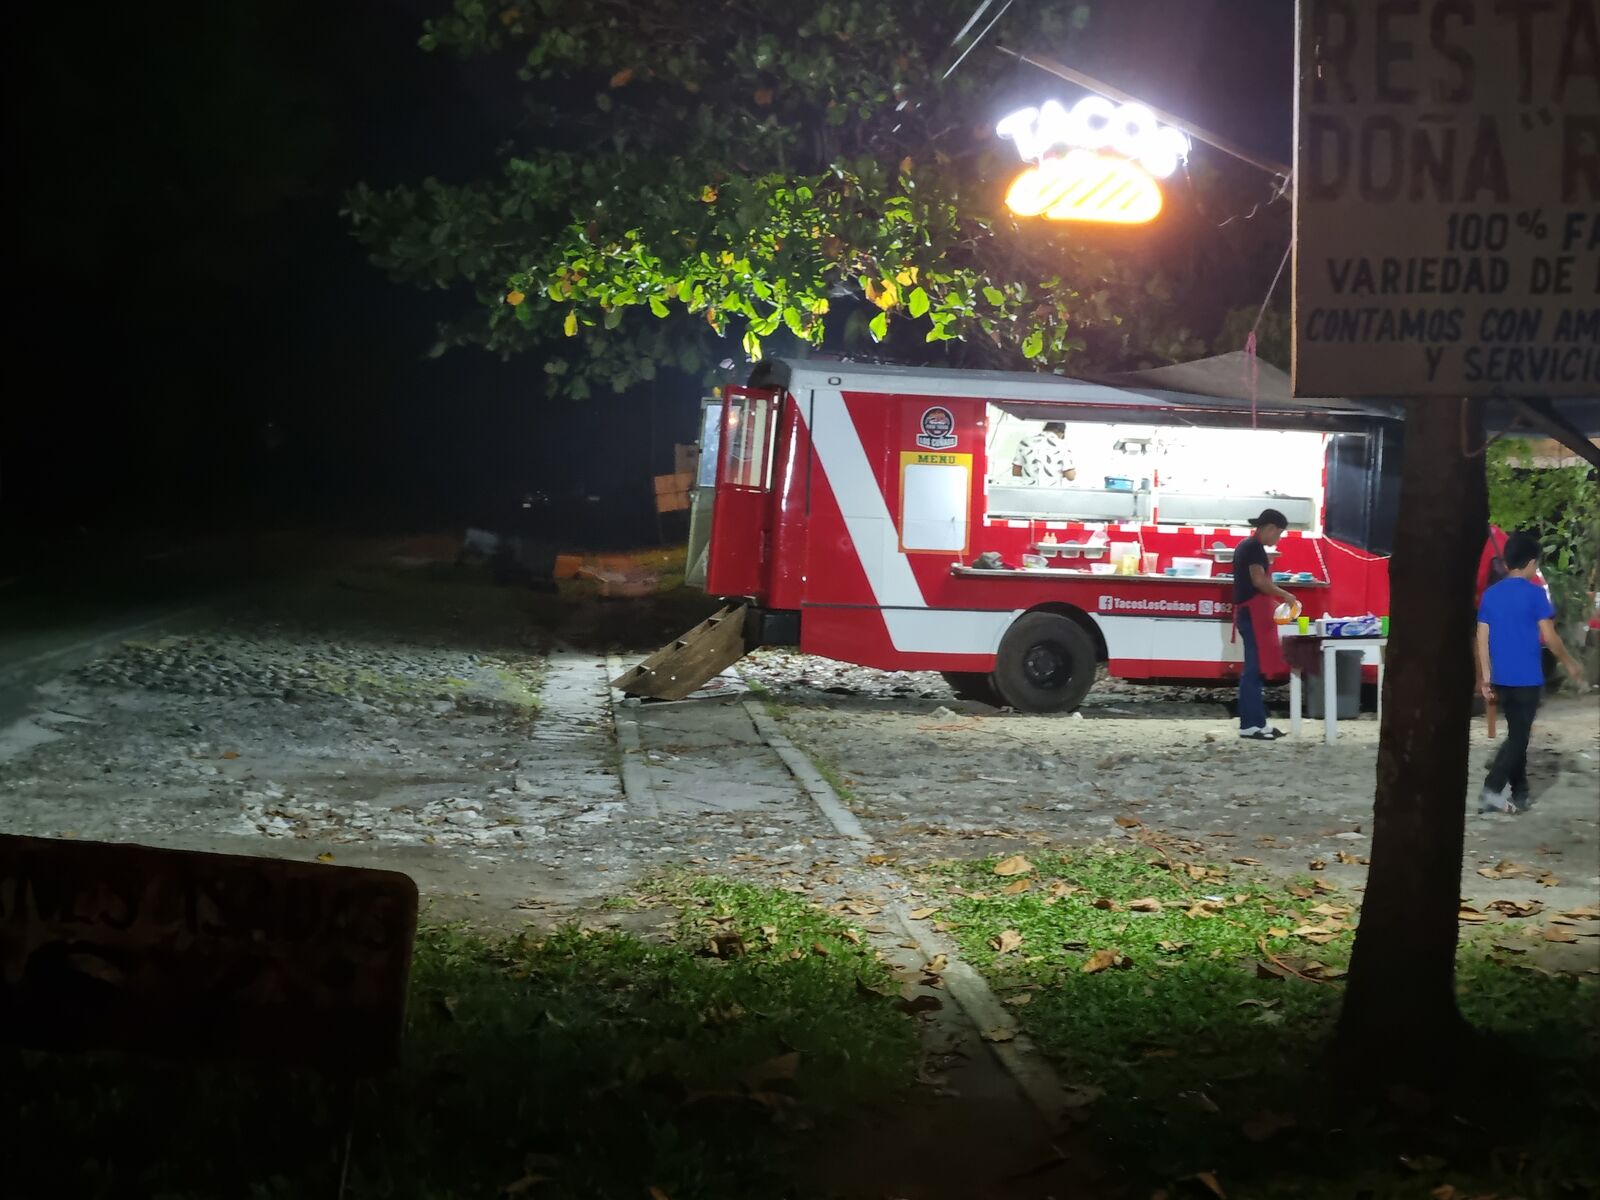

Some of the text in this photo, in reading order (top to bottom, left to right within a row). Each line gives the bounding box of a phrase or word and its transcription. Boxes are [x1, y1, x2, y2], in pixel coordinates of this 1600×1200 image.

[1306, 111, 1510, 204] DOÑA
[1447, 208, 1548, 252] 100%
[1327, 258, 1509, 295] VARIEDAD
[1529, 257, 1574, 295] DE
[1305, 308, 1465, 343] CONTAMOS
[1480, 308, 1542, 342] CON
[1425, 347, 1444, 382] Y
